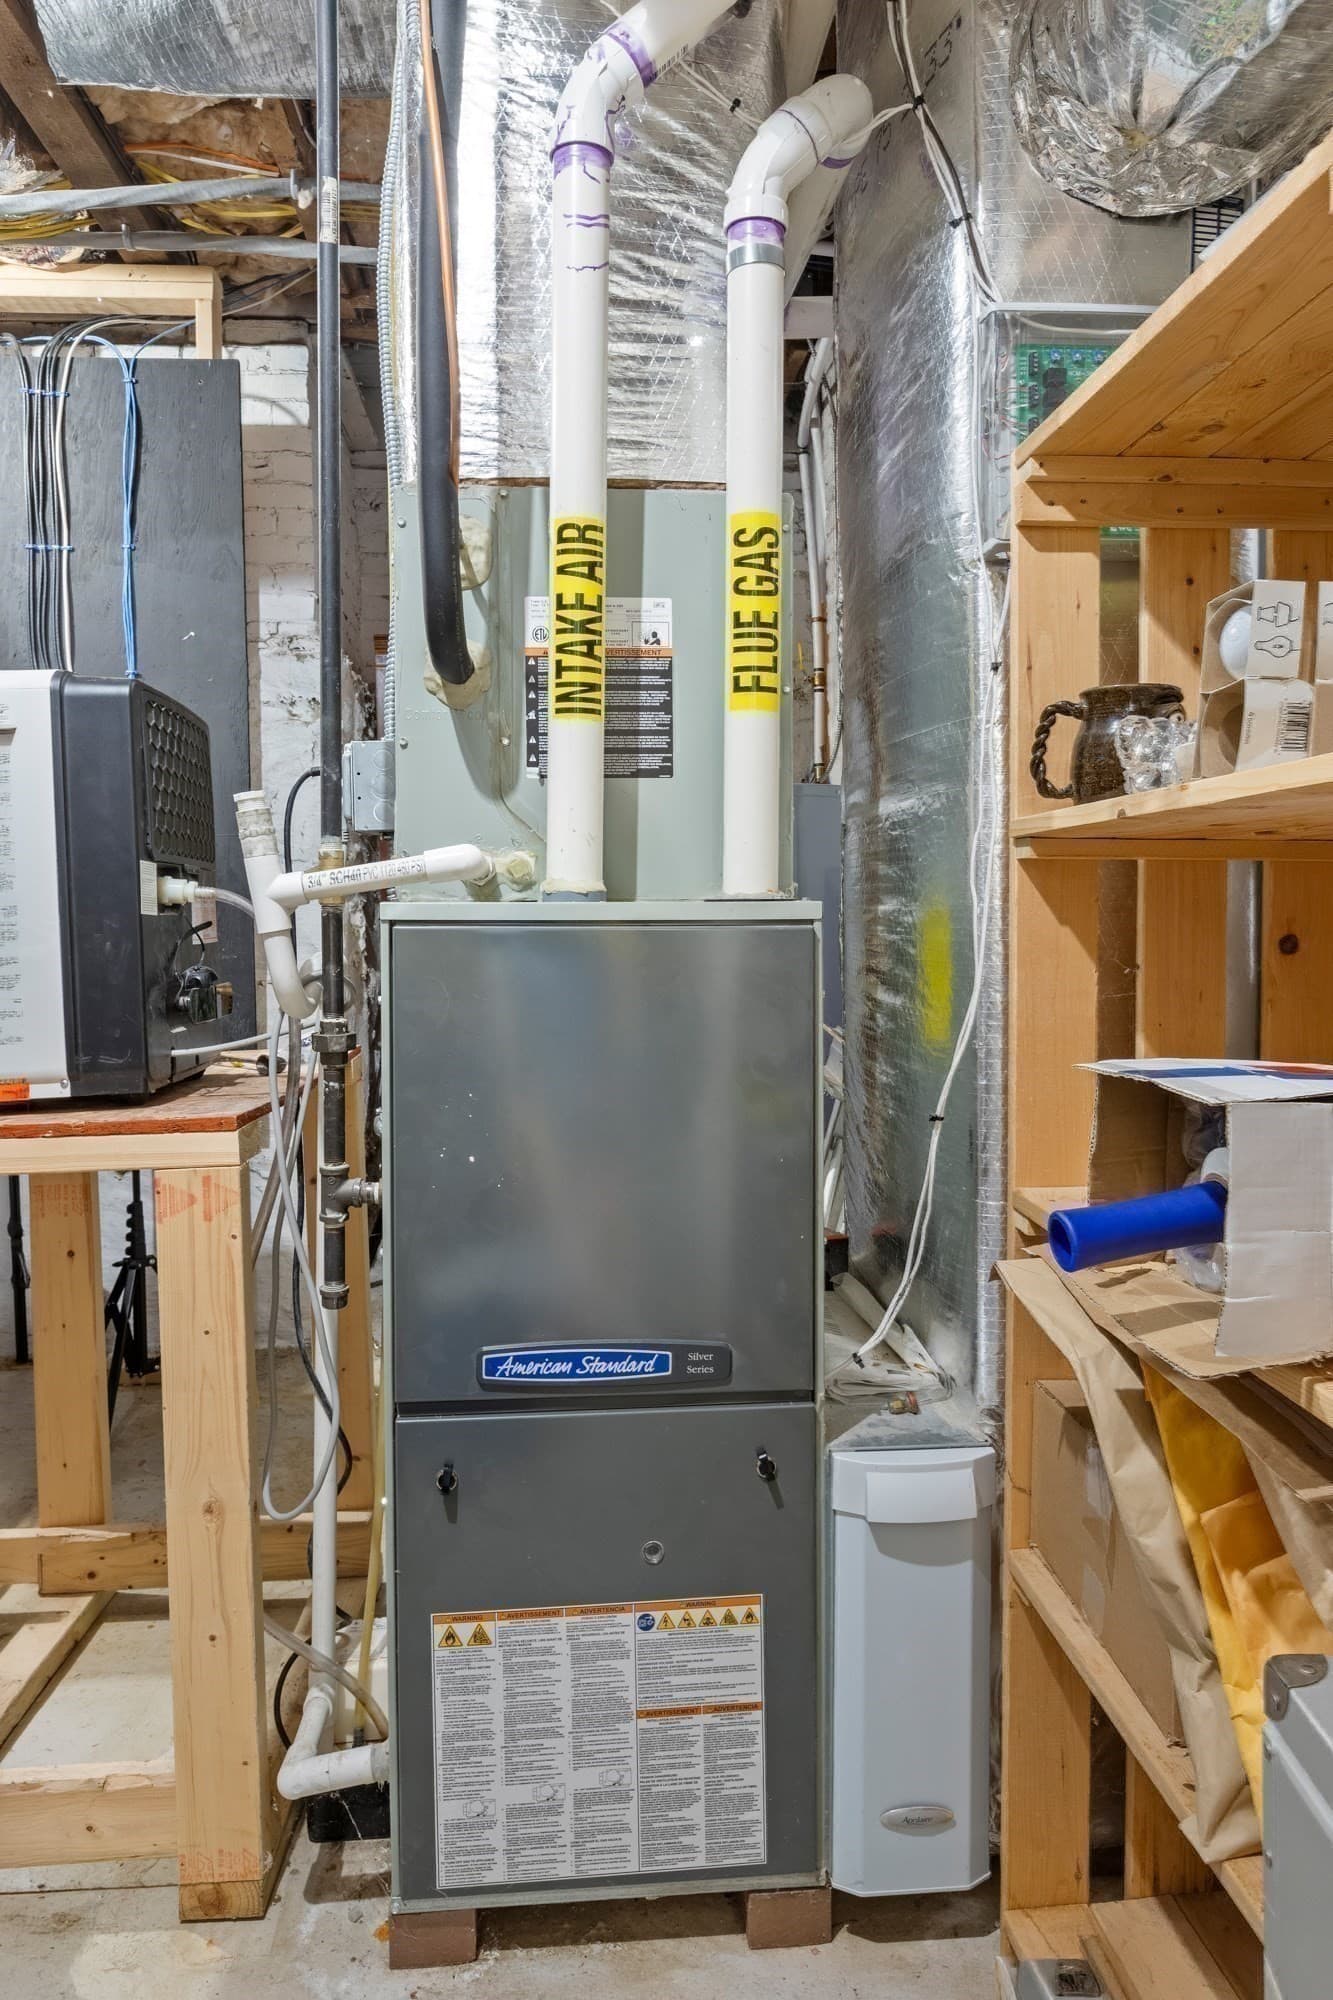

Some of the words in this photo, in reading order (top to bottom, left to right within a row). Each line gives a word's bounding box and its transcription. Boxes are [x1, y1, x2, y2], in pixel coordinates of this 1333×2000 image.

[556, 523, 604, 587] AIR
[733, 527, 780, 597] GAS
[555, 593, 603, 717] INTAKE
[733, 610, 780, 695] FLUE
[687, 1352, 714, 1361] Silver
[495, 1355, 572, 1377] American
[575, 1353, 659, 1375] Standard
[686, 1364, 714, 1374] Series
[686, 1600, 717, 1608] WARNING
[507, 1609, 561, 1619] AVERTISSEMENT
[579, 1606, 626, 1615] ADVERTENCIA
[645, 1707, 700, 1717] AVERTISSEMENT
[713, 1703, 759, 1713] ADVERTENCIA
